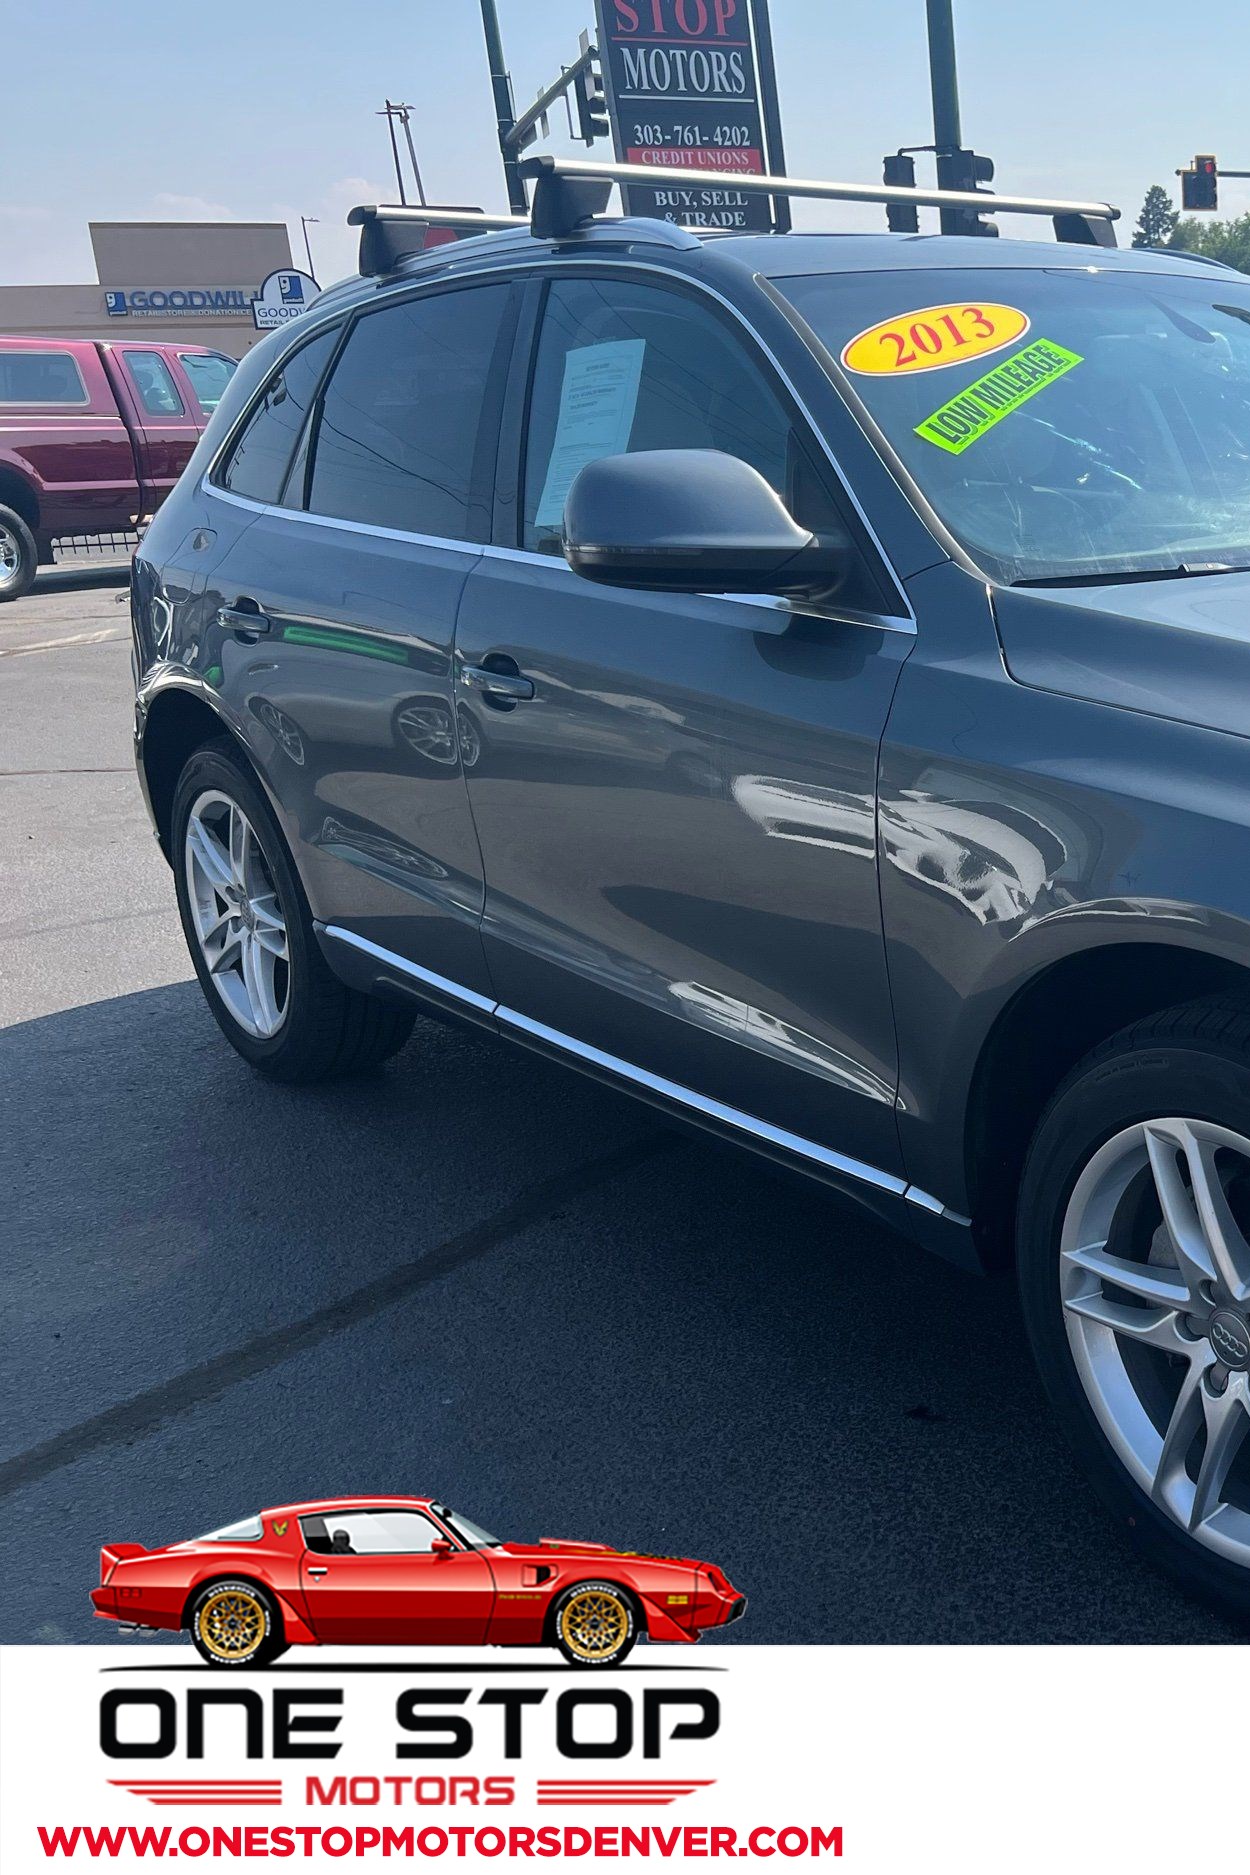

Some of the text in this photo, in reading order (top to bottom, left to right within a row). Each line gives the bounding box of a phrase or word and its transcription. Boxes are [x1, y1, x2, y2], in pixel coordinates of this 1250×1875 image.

[613, 0, 737, 37] STOP
[619, 47, 747, 94] MOTORS
[641, 150, 750, 166] CREDIT UNIONS
[654, 190, 749, 209] BUY, SELL
[664, 211, 747, 226] & TRADE
[878, 307, 996, 367] 2013
[925, 344, 1071, 445] LOW MILEAGE
